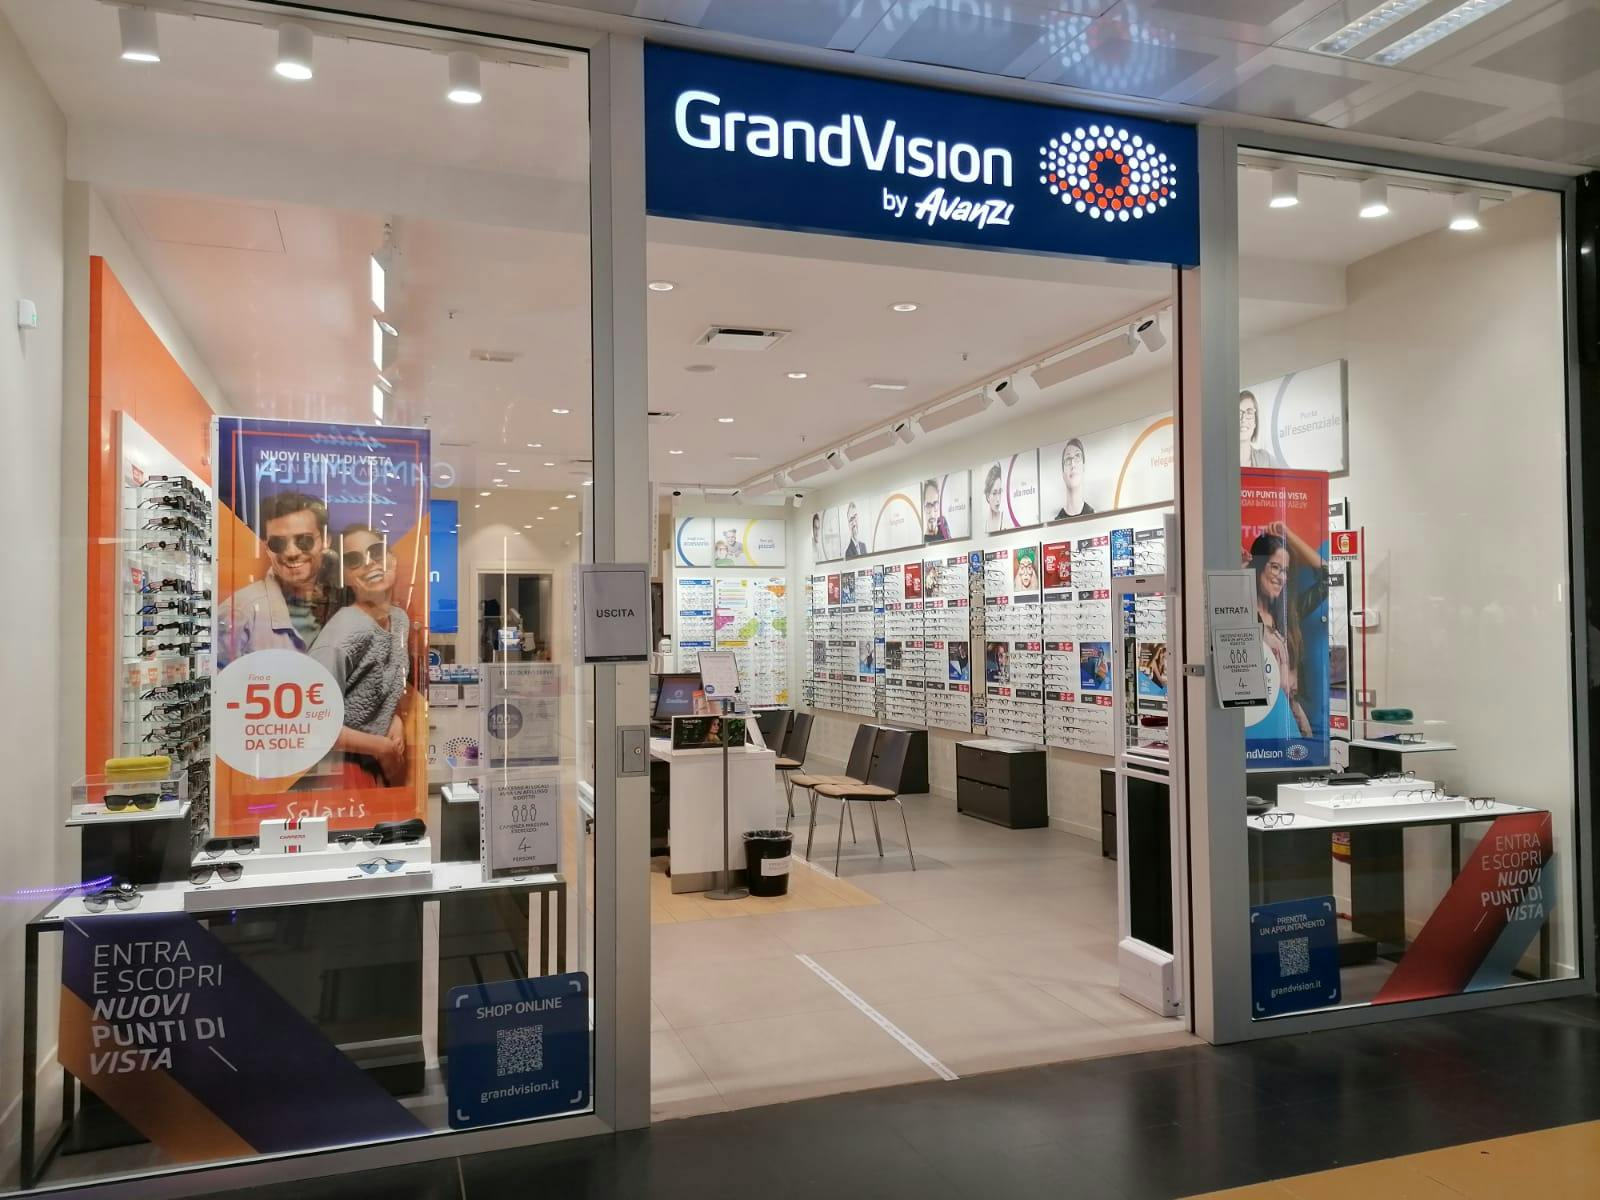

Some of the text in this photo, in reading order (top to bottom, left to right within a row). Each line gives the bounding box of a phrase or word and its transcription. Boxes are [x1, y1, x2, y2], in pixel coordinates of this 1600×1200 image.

[675, 89, 1013, 188] GrandVision
[882, 187, 1016, 230] by Avanzi
[1279, 415, 1341, 438] all'essenziale
[260, 450, 393, 466] NUOVI PUNTI DI VISTA
[1256, 490, 1277, 498] PUNTI
[1288, 492, 1307, 500] VISTA
[596, 608, 635, 618] USCITA
[1214, 607, 1249, 615] ENTRATA
[248, 673, 265, 681] Fino
[305, 708, 331, 721] sugli
[244, 723, 311, 736] OCCHIALI
[245, 737, 305, 751] DA SOLE
[1246, 749, 1283, 759] ndVision
[286, 798, 366, 820] Solaris
[518, 836, 532, 852] 4
[1496, 832, 1541, 851] ENTRA
[1481, 850, 1542, 871] E SCOPRI
[1498, 868, 1541, 887] NUOVI
[1481, 885, 1543, 907] PUNTI DI
[1277, 914, 1307, 925] PRENOTA
[1505, 903, 1544, 922] VISTA
[1260, 919, 1326, 936] UN APPUNTAMENTO
[94, 940, 192, 967] ENTRA
[93, 964, 223, 994] E SCOPRI
[1270, 980, 1322, 999] grandvision.it
[92, 992, 191, 1021] NUOVI
[476, 996, 562, 1020] SHOP ONLINE
[91, 1016, 226, 1048] PUNTI DI
[90, 1047, 173, 1076] VISTA
[480, 1080, 560, 1104] grandvision.it
